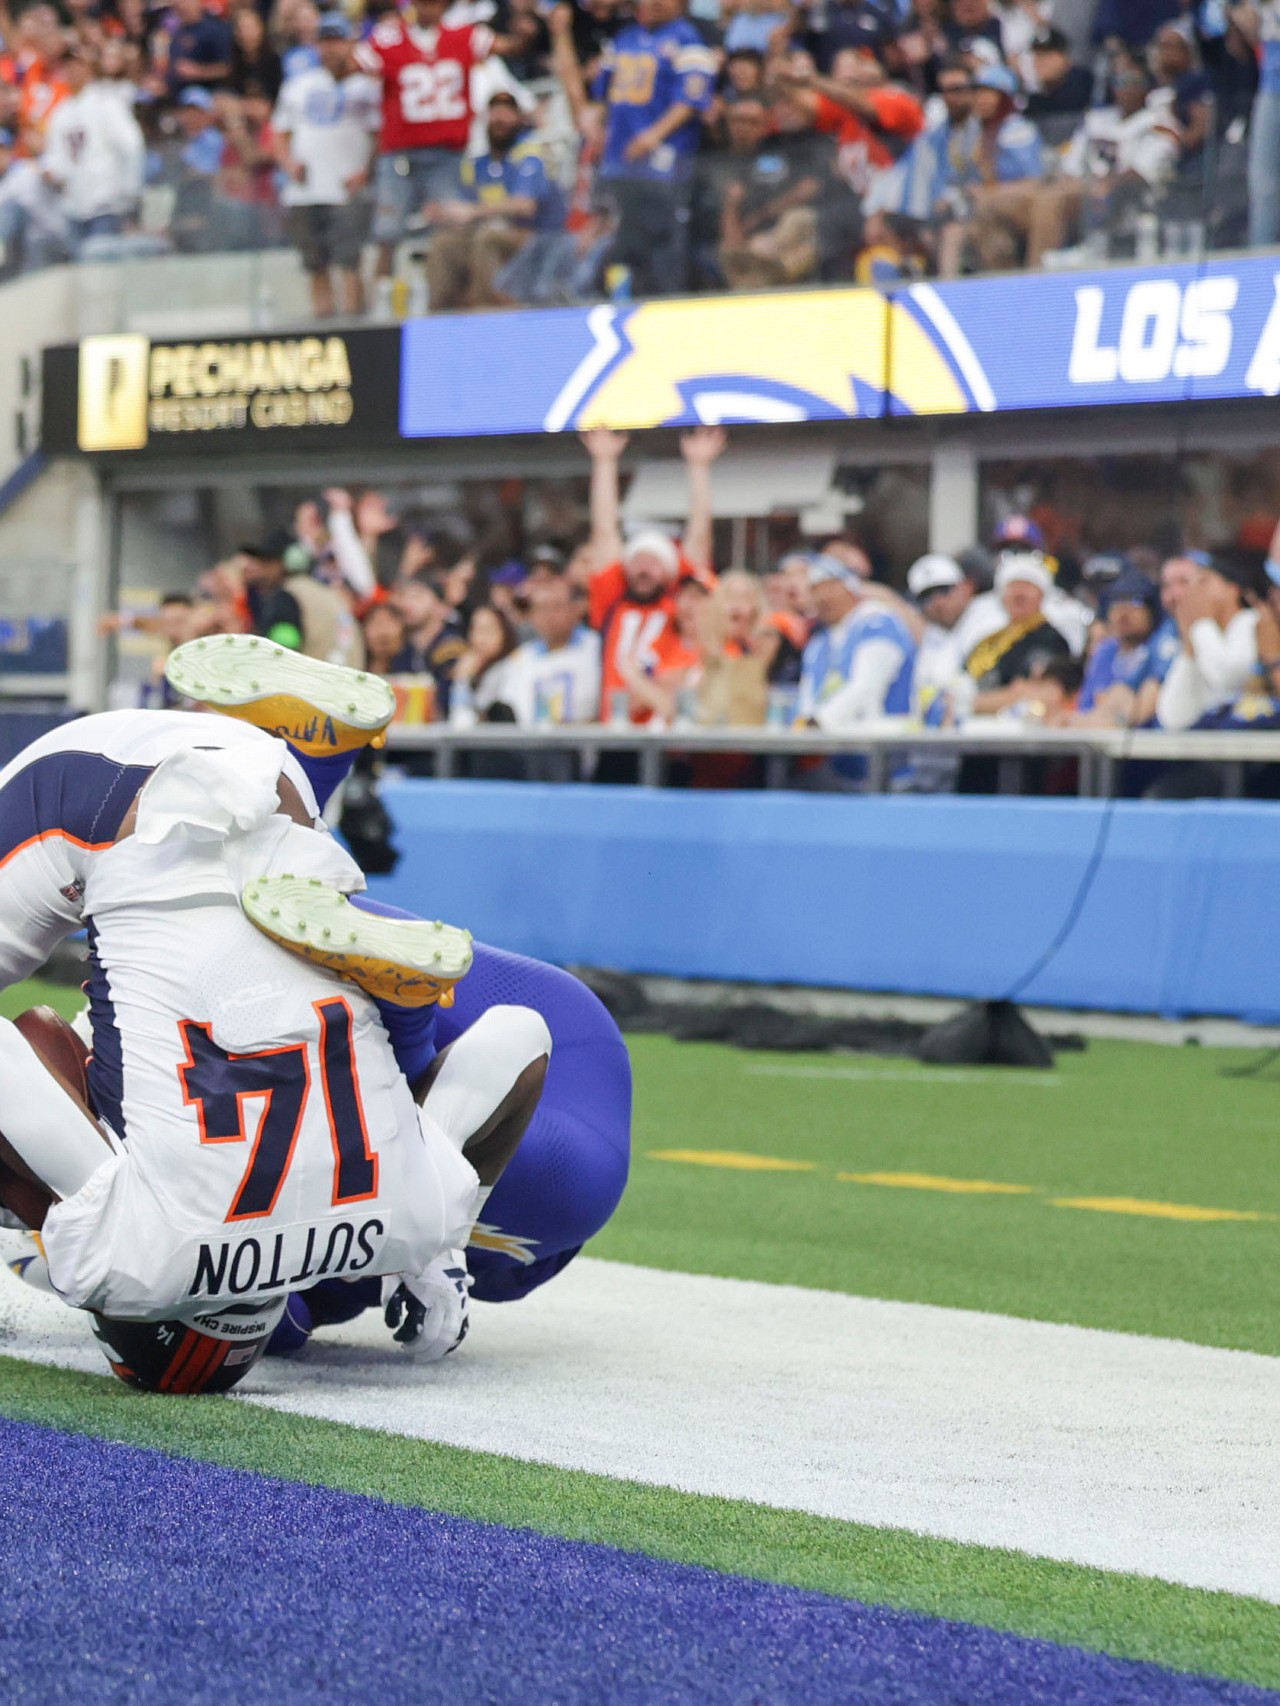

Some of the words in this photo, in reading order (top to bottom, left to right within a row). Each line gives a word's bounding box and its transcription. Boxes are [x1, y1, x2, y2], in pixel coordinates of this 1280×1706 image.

[399, 58, 467, 124] 22
[1068, 274, 1239, 384] LOS
[148, 336, 352, 397] PECHANGA
[176, 995, 380, 1223] 14
[187, 1217, 385, 1297] SUTTON
[156, 1325, 175, 1346] 14
[221, 1321, 266, 1336] INSPIRE
